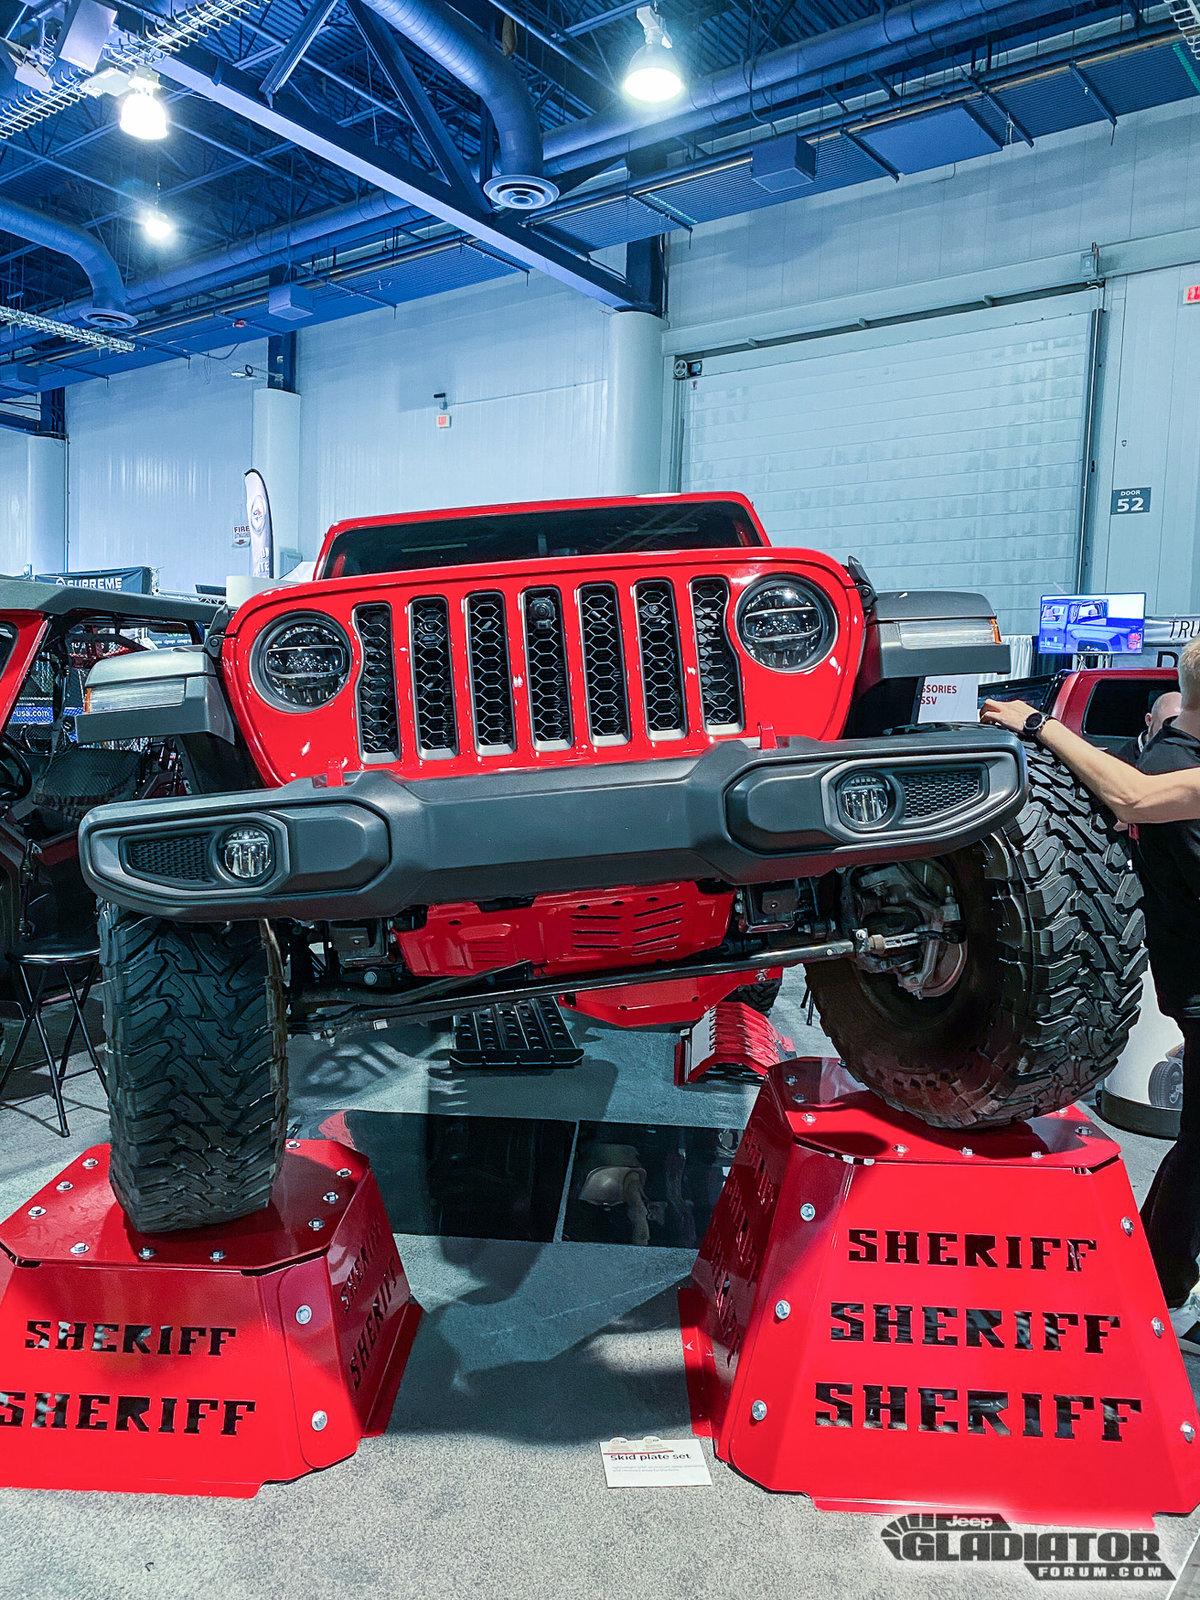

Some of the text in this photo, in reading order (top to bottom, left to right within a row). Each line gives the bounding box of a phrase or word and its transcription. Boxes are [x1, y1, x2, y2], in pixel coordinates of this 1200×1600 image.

[1117, 498, 1143, 512] 52
[848, 1228, 1097, 1272] SHERIFF
[25, 1320, 237, 1356] SHERIFF
[830, 1301, 1121, 1354] SHERIFF
[0, 1391, 256, 1437] SHERIFF
[815, 1382, 1143, 1442] SHERIFF
[610, 1453, 637, 1461] Skid
[640, 1453, 670, 1461] plate
